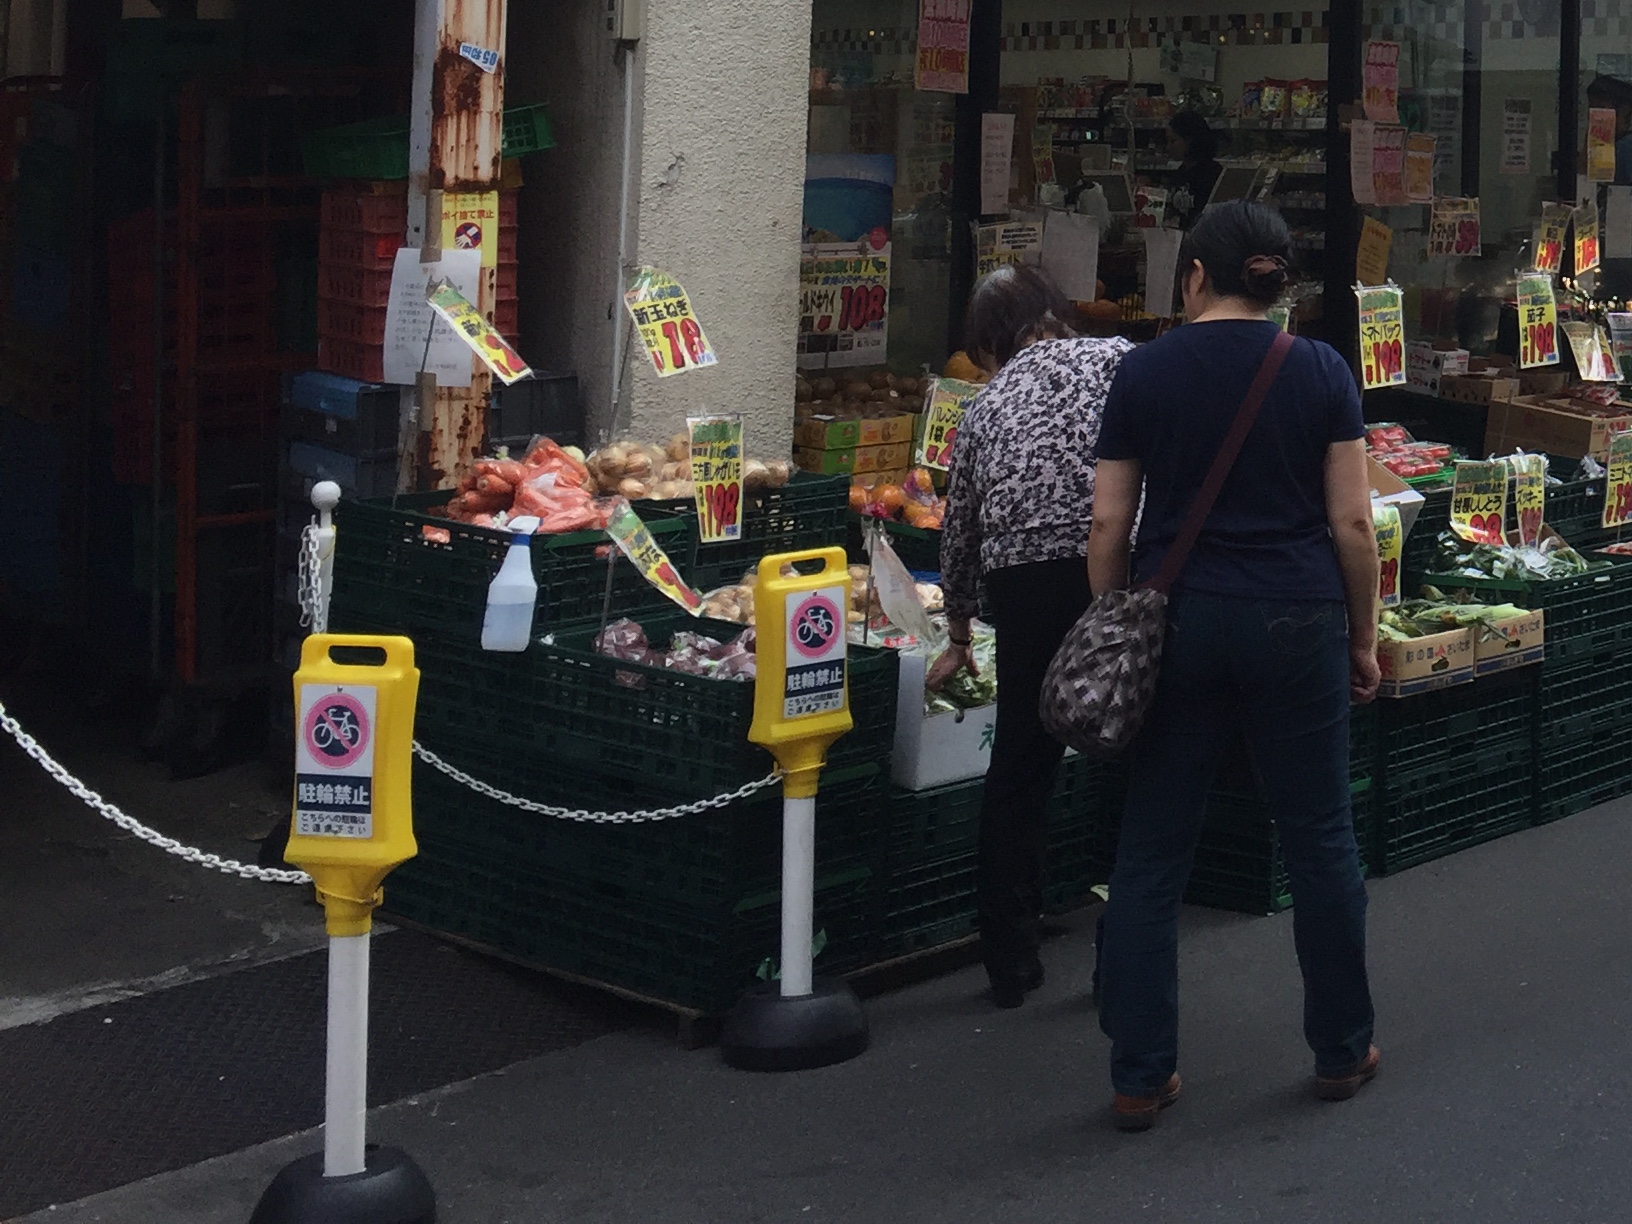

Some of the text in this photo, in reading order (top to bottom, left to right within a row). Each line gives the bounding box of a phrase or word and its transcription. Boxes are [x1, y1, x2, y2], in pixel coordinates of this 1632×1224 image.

[632, 298, 690, 326] 新玉ねぎ
[838, 284, 887, 332] 108
[704, 481, 740, 537] 198
[787, 665, 844, 692] 駐輪禁止
[298, 782, 370, 806] 駐輪禁止
